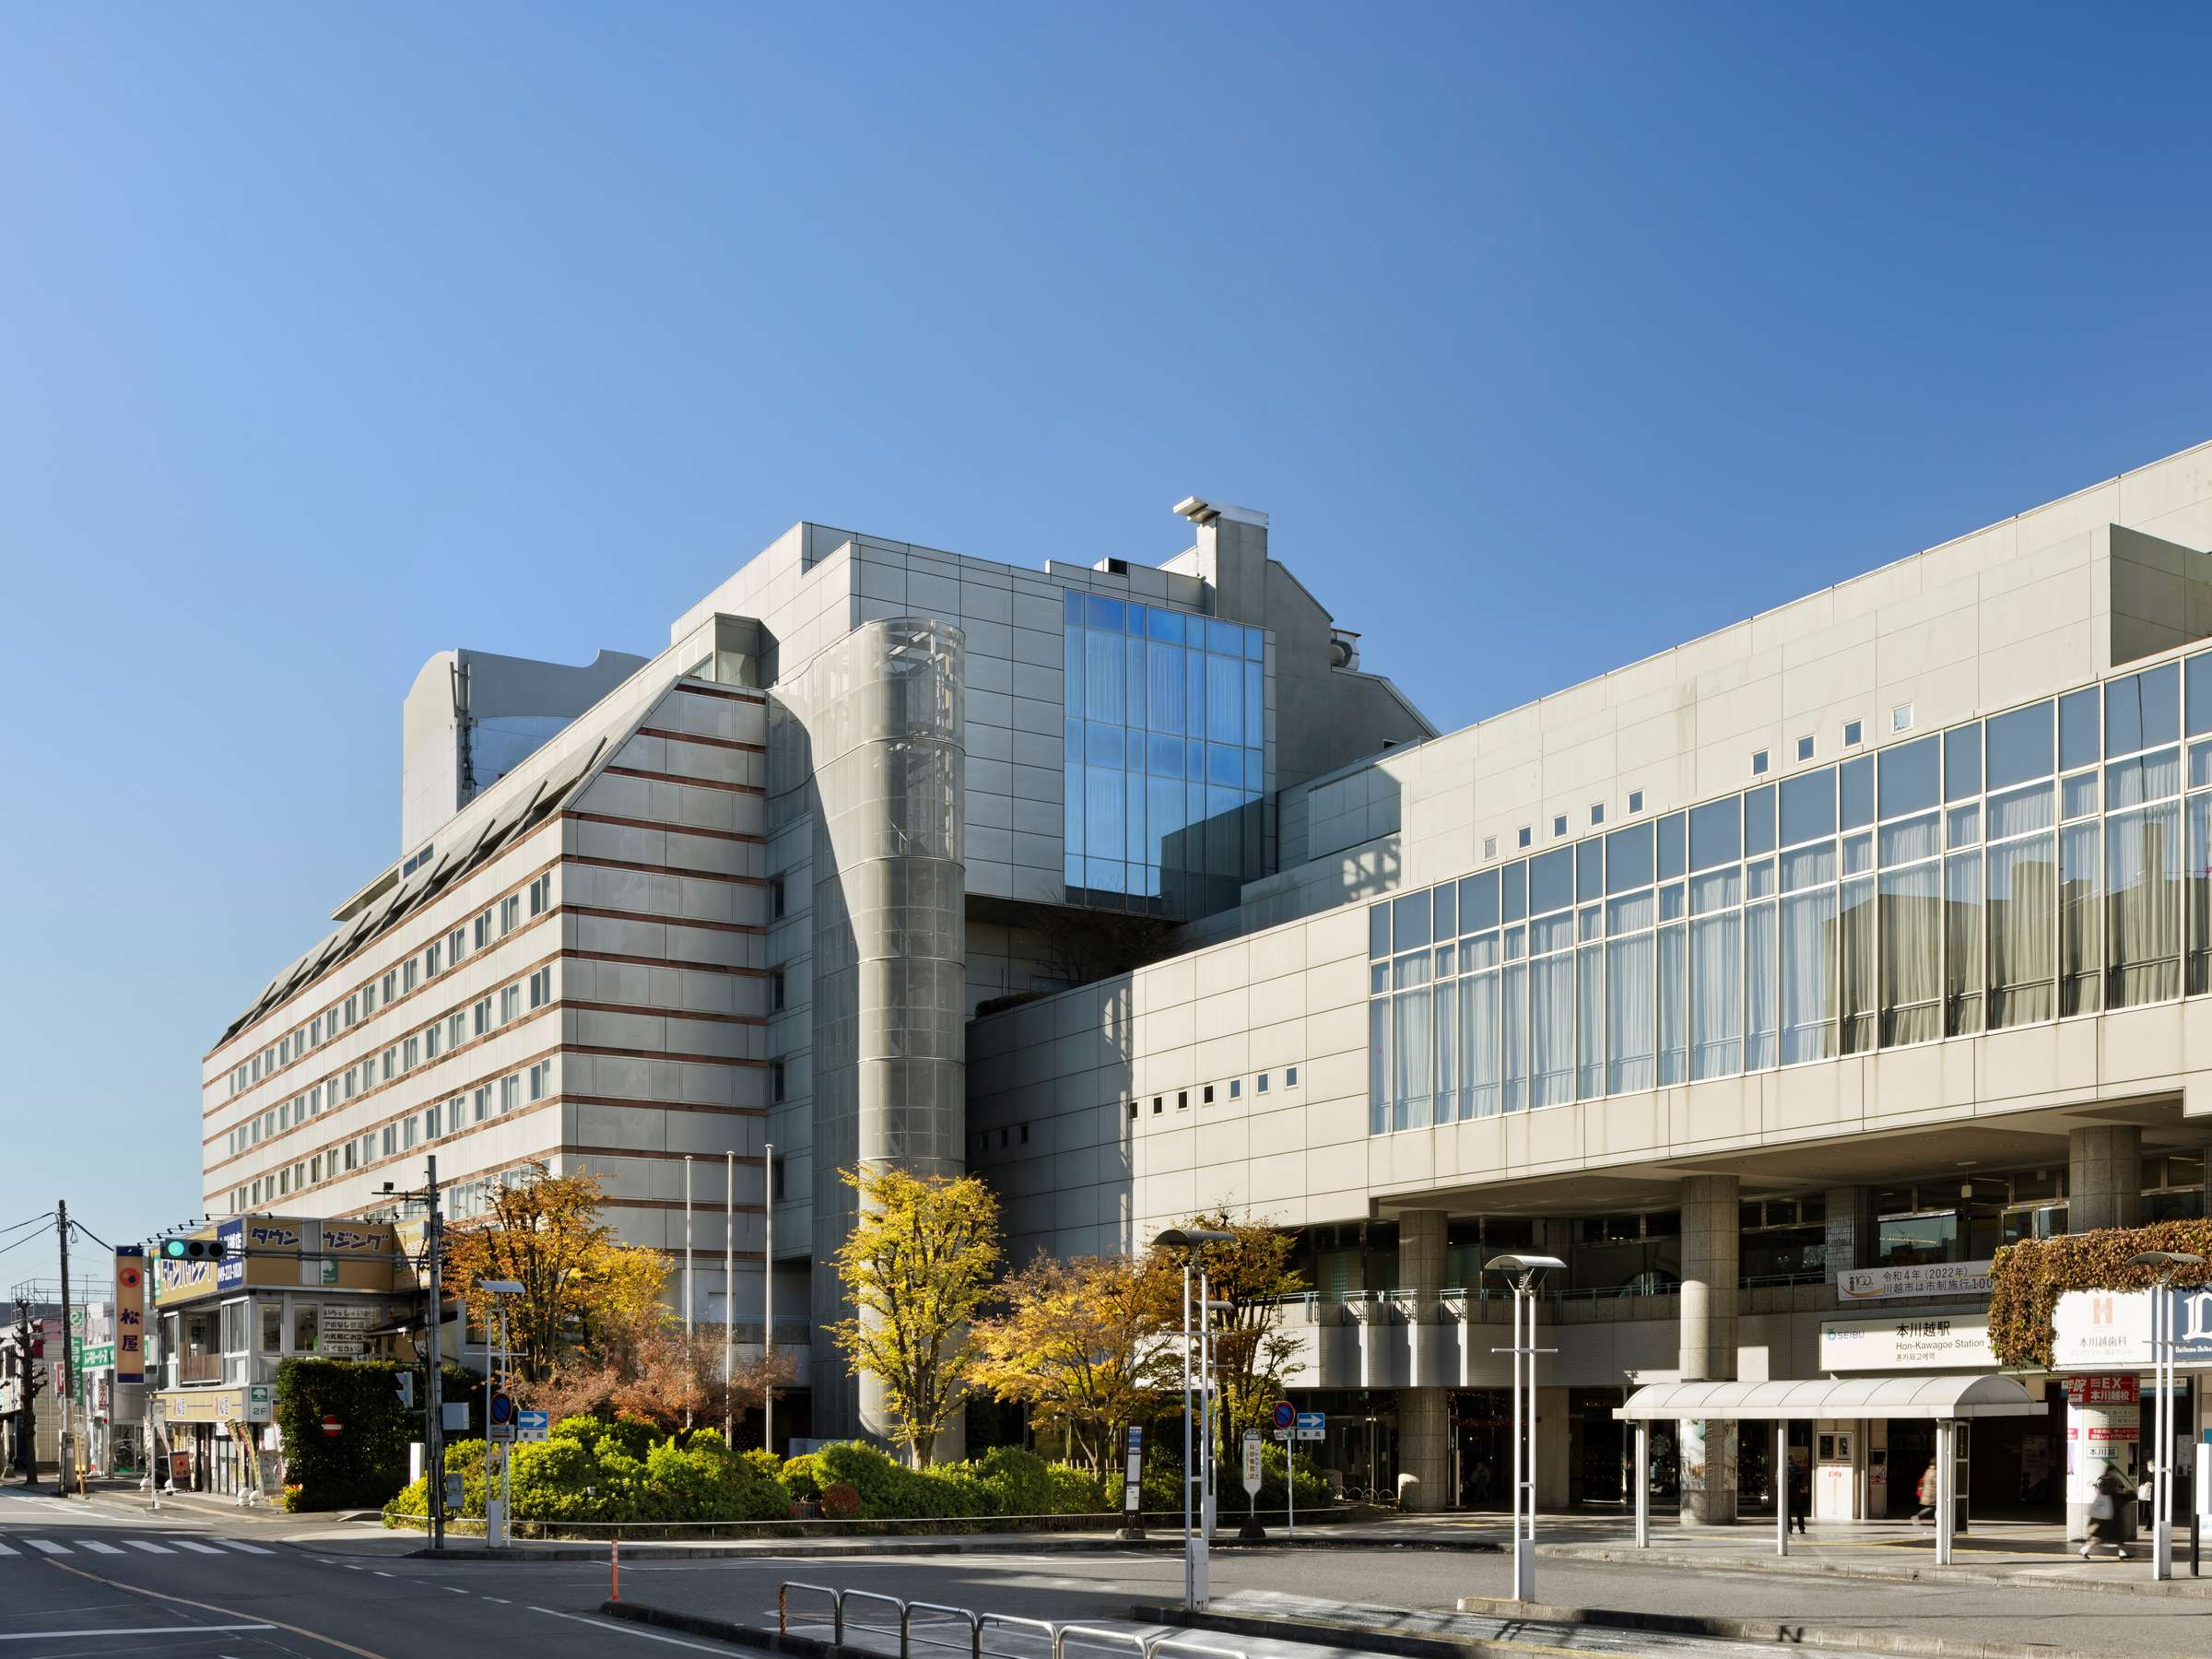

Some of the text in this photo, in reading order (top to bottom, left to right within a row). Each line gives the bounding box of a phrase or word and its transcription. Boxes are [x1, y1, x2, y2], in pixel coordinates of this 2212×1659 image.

[251, 1227, 300, 1246] タウン
[120, 1308, 140, 1352] 松屋
[1837, 1330, 1865, 1340] SEIBU
[1896, 1321, 1950, 1337] 本川越駅
[1896, 1339, 1984, 1351] Hon-Kawagoe Station
